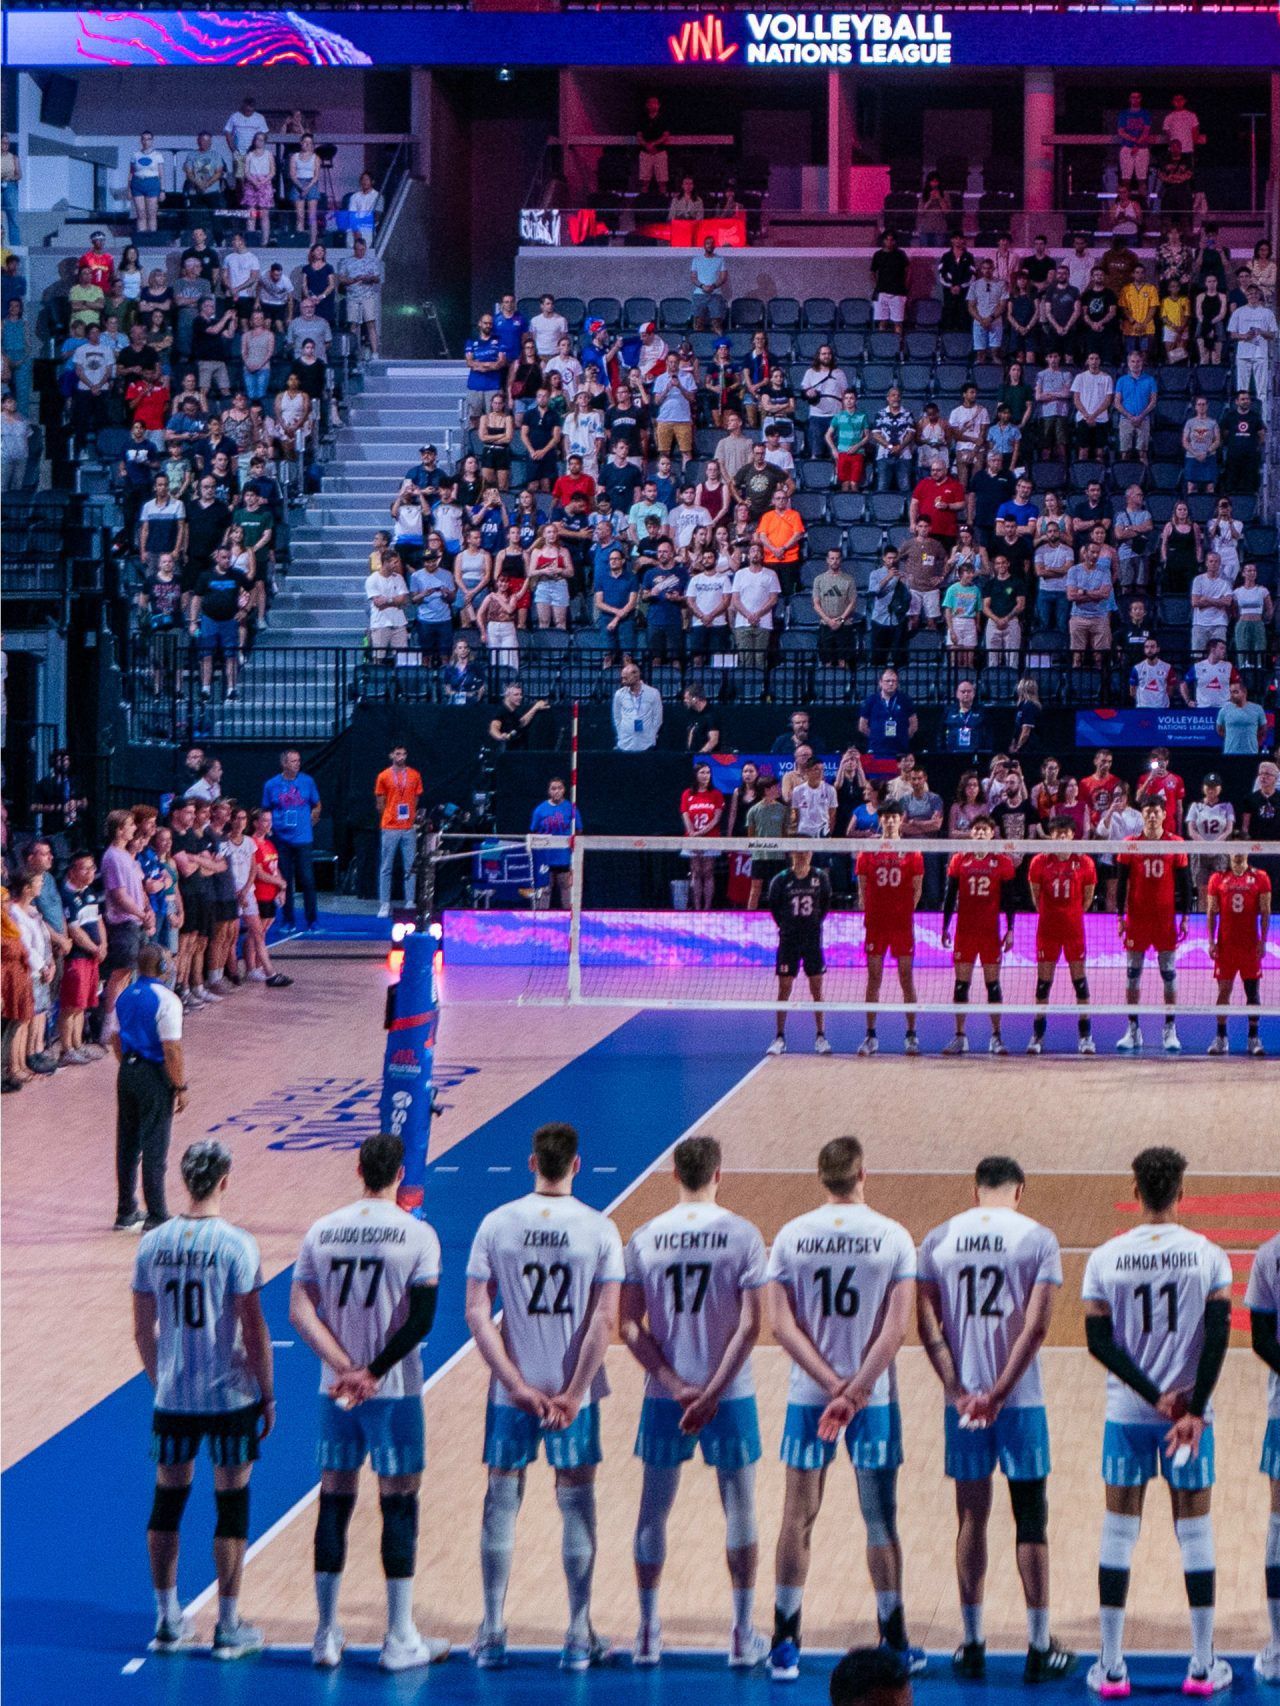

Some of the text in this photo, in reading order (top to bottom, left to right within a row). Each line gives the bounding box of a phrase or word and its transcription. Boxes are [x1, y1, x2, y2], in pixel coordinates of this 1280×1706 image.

[746, 13, 952, 41] VOLLEYBALL
[669, 14, 738, 63] VNL
[747, 43, 952, 63] NATIONS LEAGUE
[1158, 715, 1216, 724] VOLLEYBALL
[694, 813, 709, 829] 12
[1202, 819, 1220, 834] 12
[876, 867, 902, 887] 30
[1143, 859, 1165, 878] 10
[967, 876, 990, 896] 12
[1052, 878, 1071, 898] 11
[791, 896, 814, 916] 13
[523, 1229, 570, 1248] ZERBA
[654, 1232, 728, 1250] VICENTIN
[796, 1237, 883, 1255] KUKARTSEV
[956, 1236, 991, 1253] LIMA
[1116, 1252, 1198, 1271] ARMOA MOREL
[331, 1257, 385, 1308] 77
[522, 1262, 574, 1315] 22
[665, 1262, 712, 1315] 17
[813, 1265, 861, 1317] 16
[958, 1265, 1005, 1317] 12
[165, 1279, 206, 1329] 10
[1134, 1282, 1179, 1335] 11
